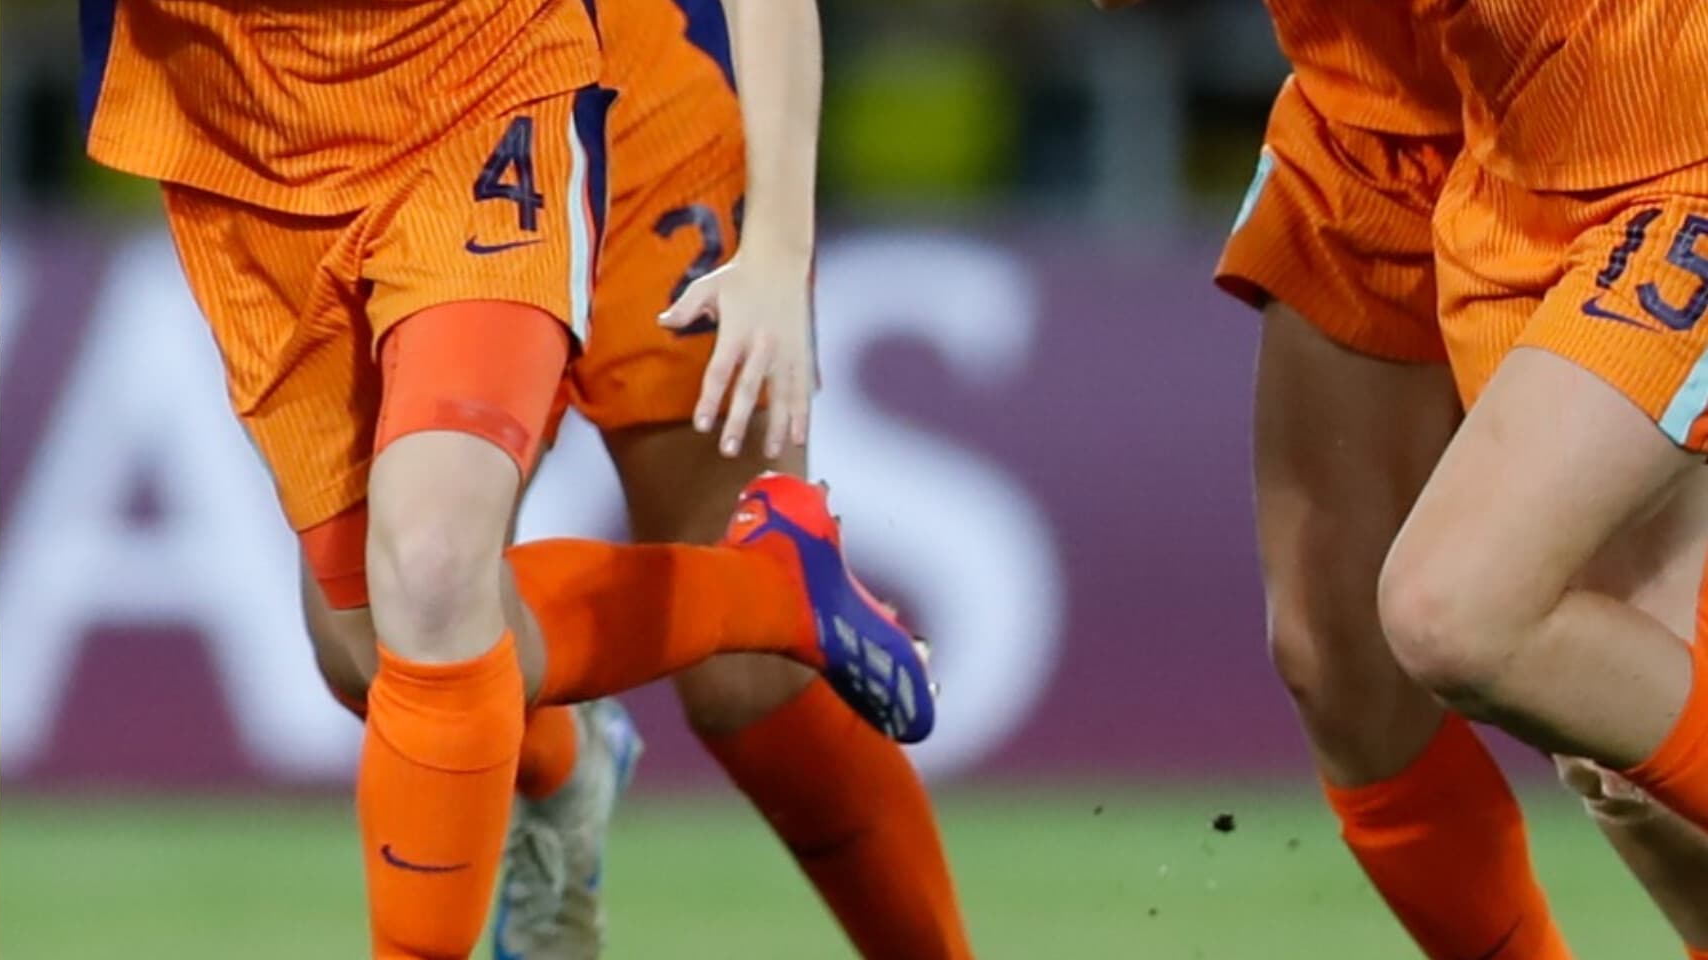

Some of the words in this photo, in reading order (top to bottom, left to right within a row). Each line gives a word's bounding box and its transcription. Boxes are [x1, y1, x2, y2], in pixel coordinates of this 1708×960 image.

[473, 116, 544, 232] 4
[653, 193, 745, 337] 2
[1596, 208, 1708, 330] 15
